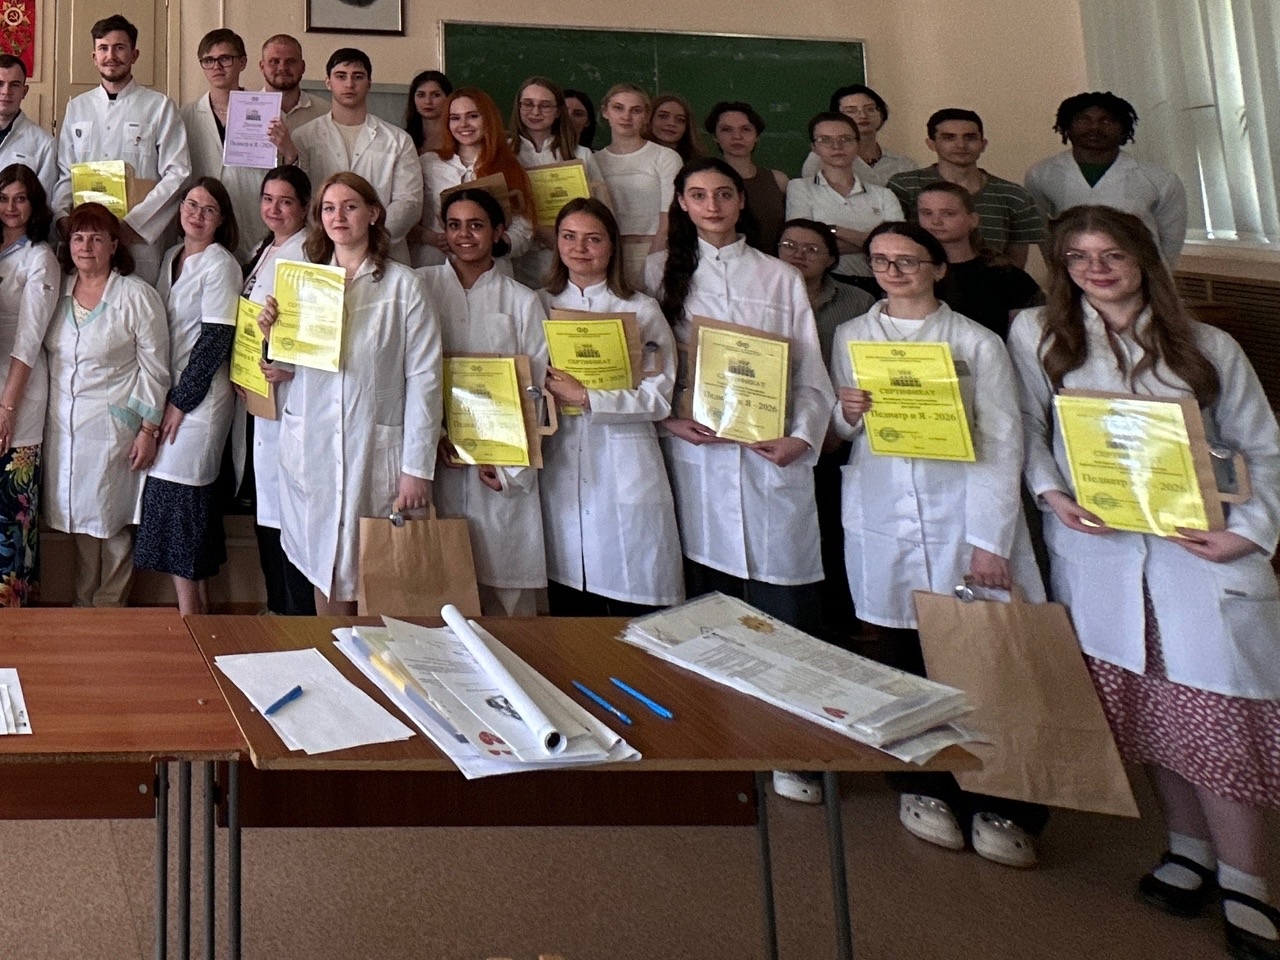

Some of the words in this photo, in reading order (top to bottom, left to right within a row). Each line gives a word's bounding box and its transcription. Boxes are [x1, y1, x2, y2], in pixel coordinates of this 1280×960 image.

[759, 402, 777, 412] 2026
[871, 410, 908, 420] Педиатр
[934, 413, 956, 421] 2026
[1082, 473, 1128, 487] Педиатр
